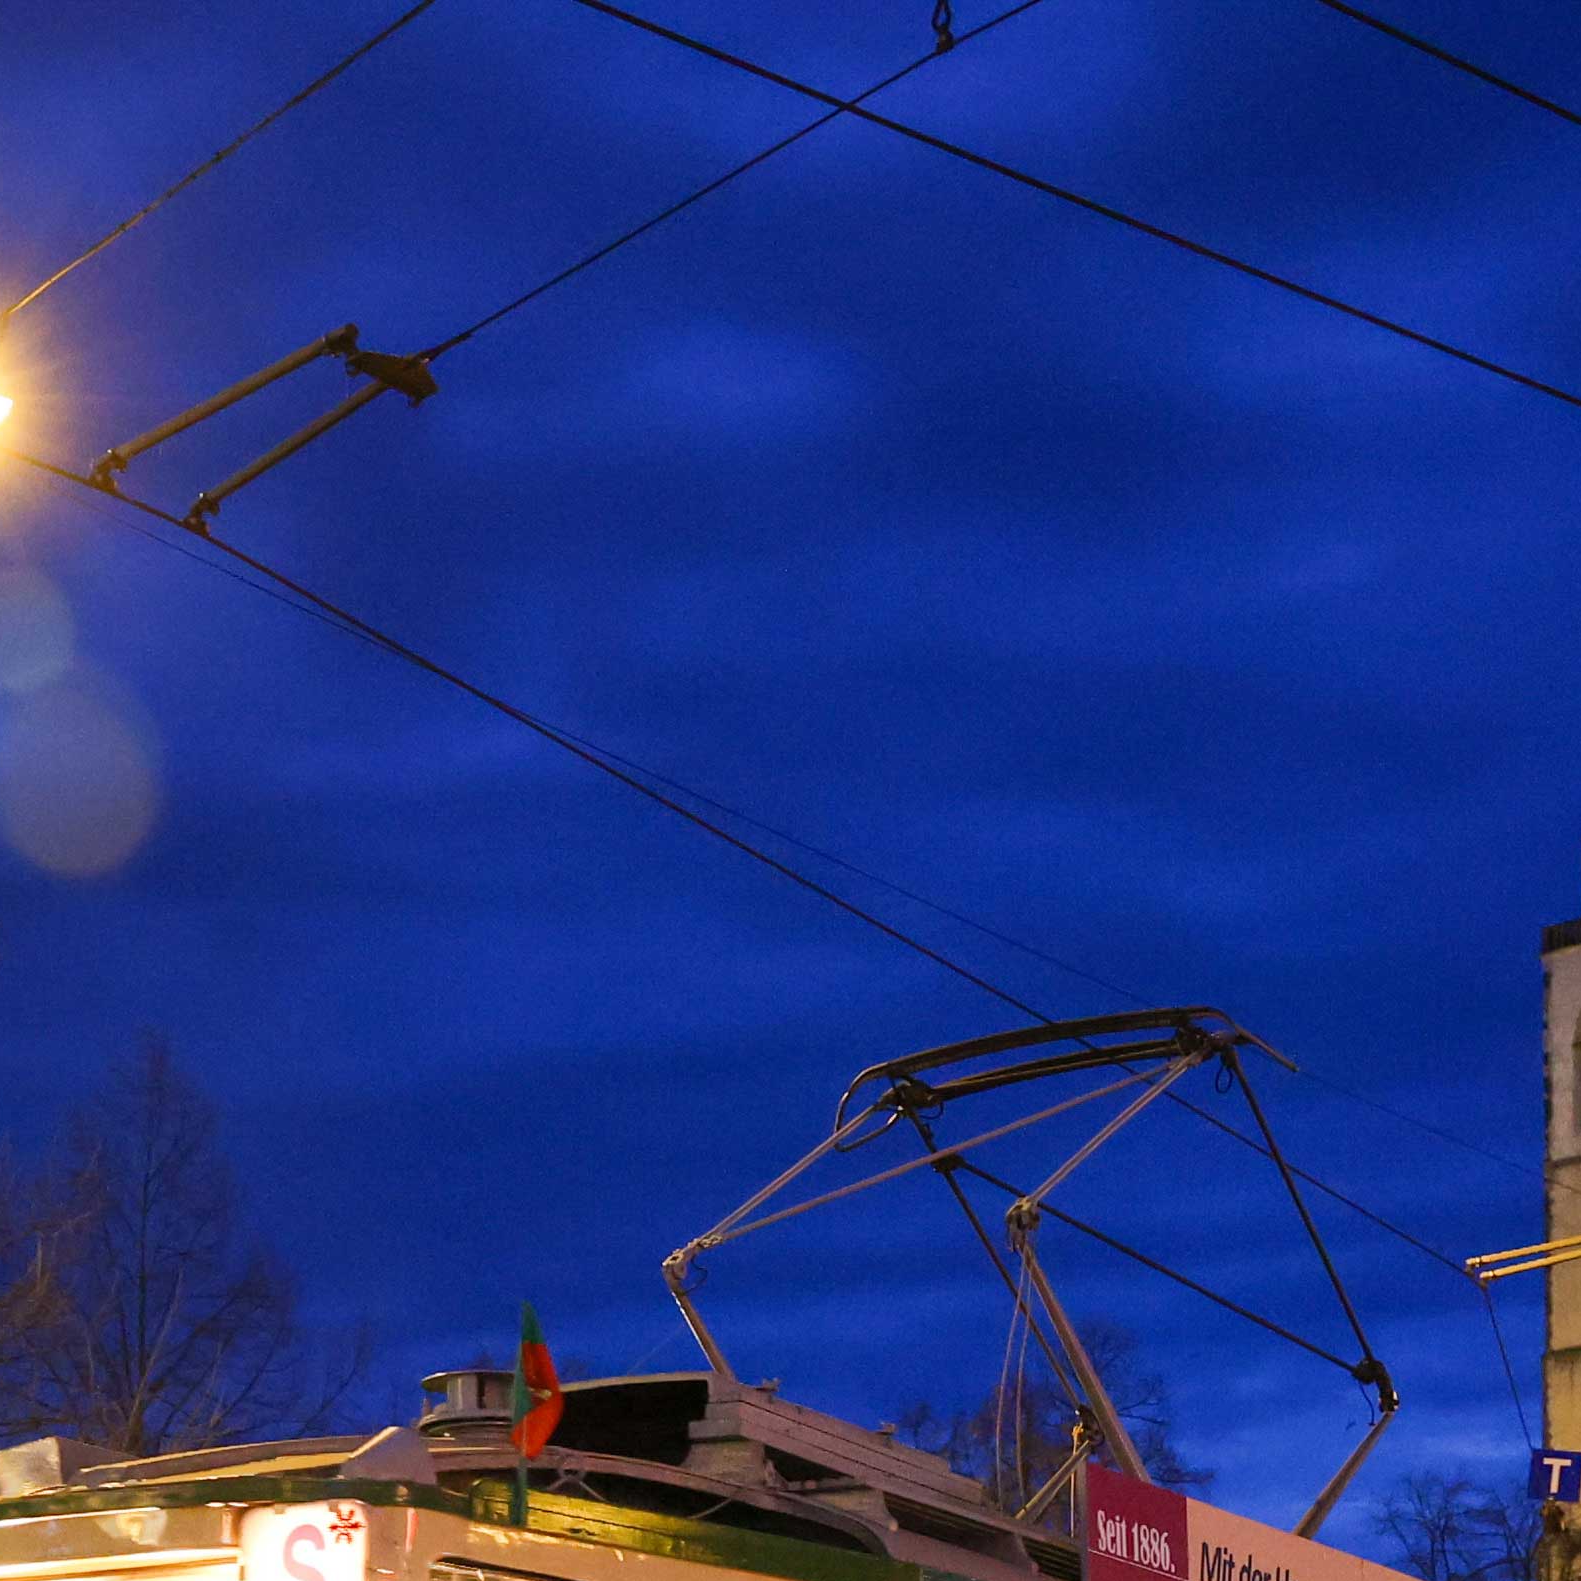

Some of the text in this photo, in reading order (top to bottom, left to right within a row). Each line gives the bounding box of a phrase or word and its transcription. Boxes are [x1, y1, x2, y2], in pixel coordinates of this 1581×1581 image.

[1542, 1457, 1572, 1494] T
[1096, 1509, 1176, 1574] Seit 1886.
